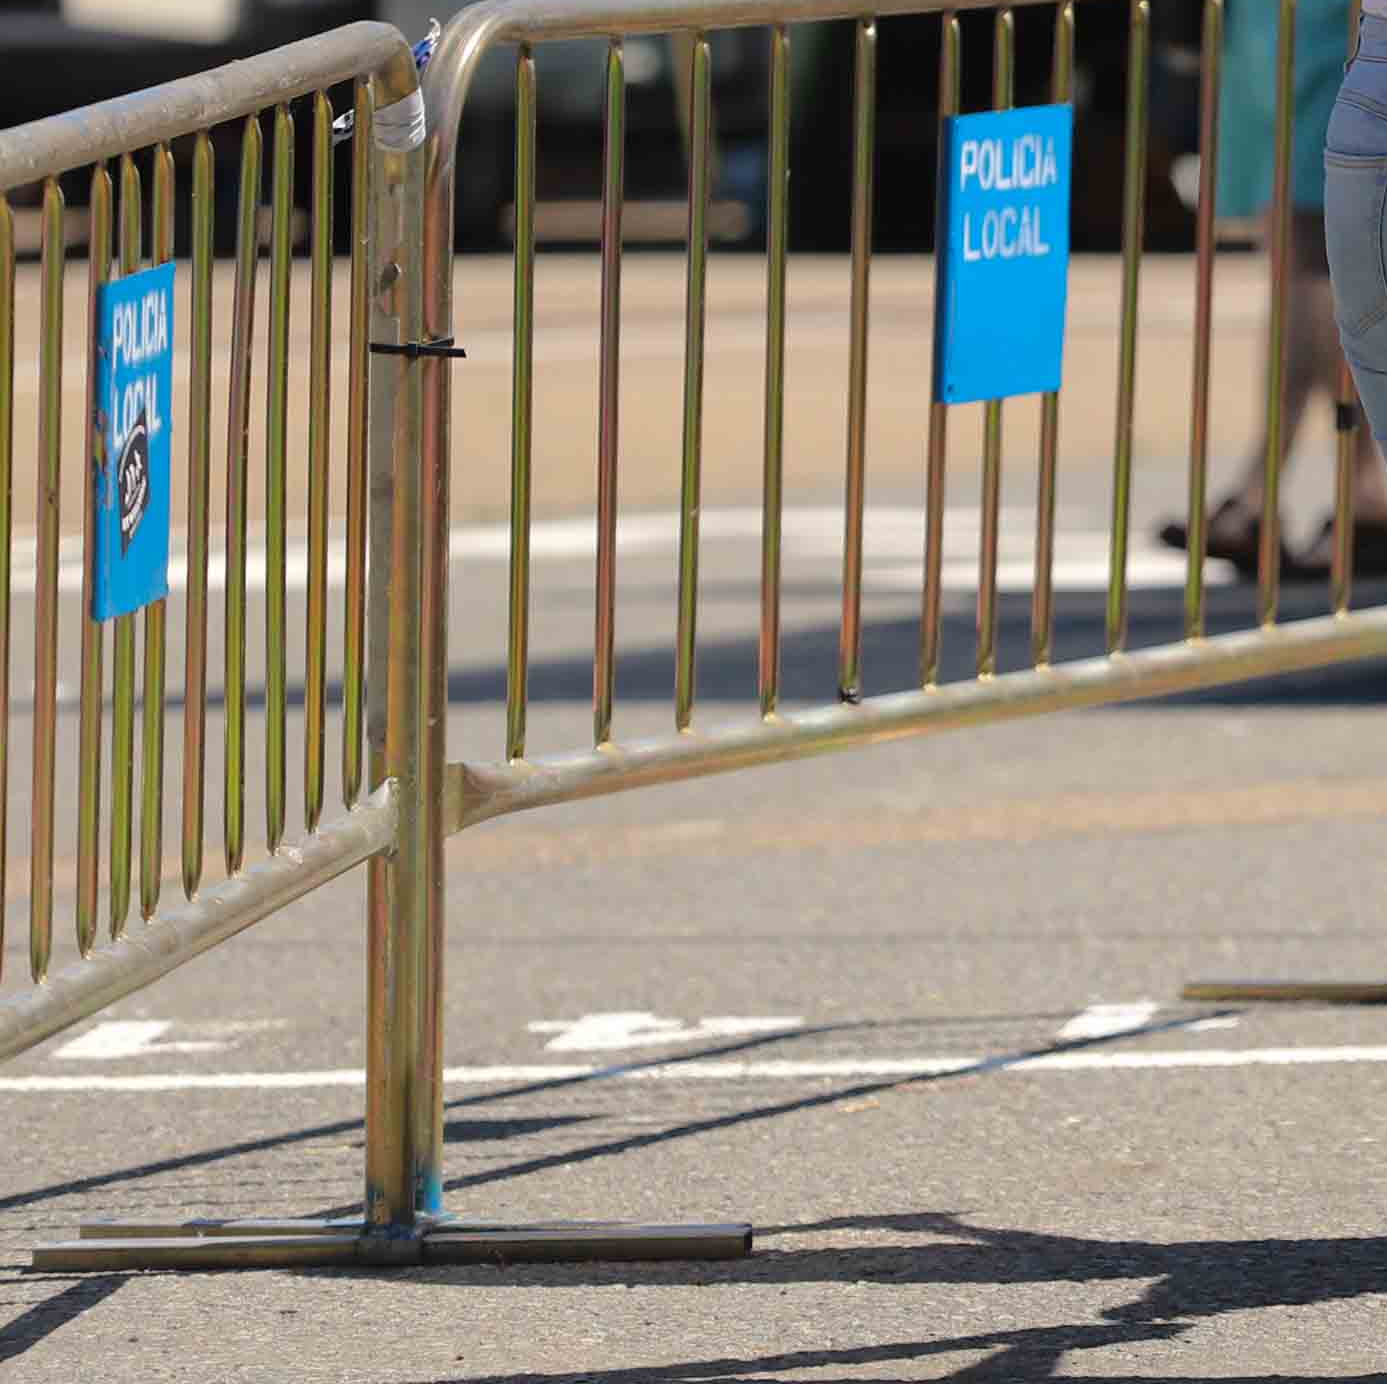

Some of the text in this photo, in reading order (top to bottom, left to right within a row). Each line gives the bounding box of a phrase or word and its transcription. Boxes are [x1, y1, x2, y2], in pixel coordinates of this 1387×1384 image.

[960, 132, 1058, 192] POLICIA
[963, 204, 1050, 262] LOCAL
[112, 287, 168, 368] POLICIA
